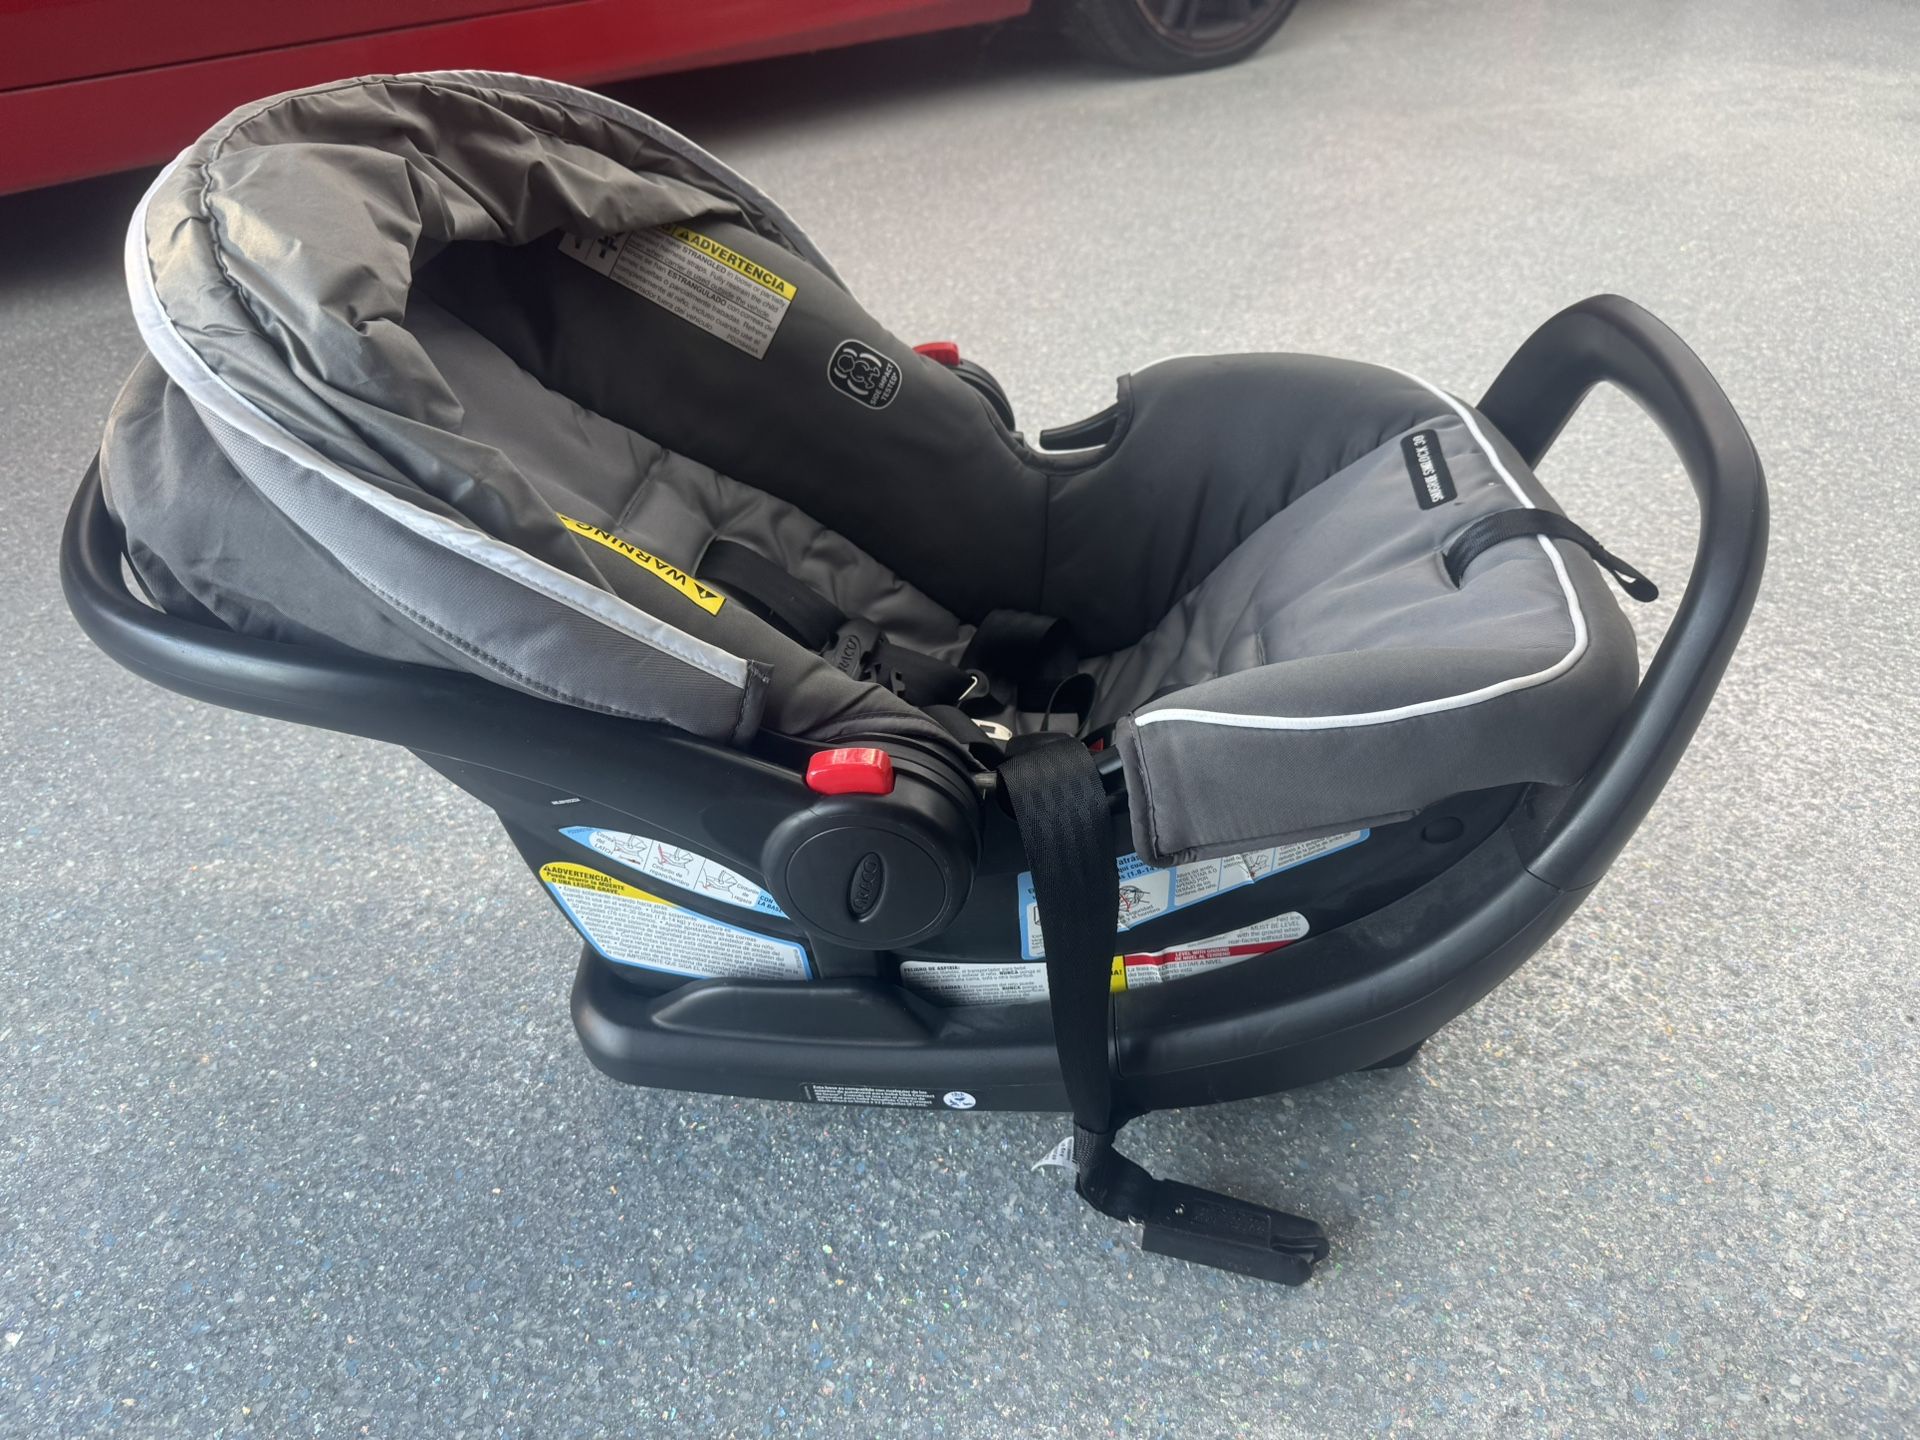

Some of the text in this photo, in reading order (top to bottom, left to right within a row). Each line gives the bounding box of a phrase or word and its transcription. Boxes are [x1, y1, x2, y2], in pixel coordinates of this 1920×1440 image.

[681, 245, 726, 274] STRANGLED
[690, 233, 786, 291] ADVERTENCIA
[869, 363, 893, 405] SIDE IMPACT
[1412, 434, 1426, 446] 30
[838, 637, 857, 672] RACO
[759, 895, 773, 903] CON
